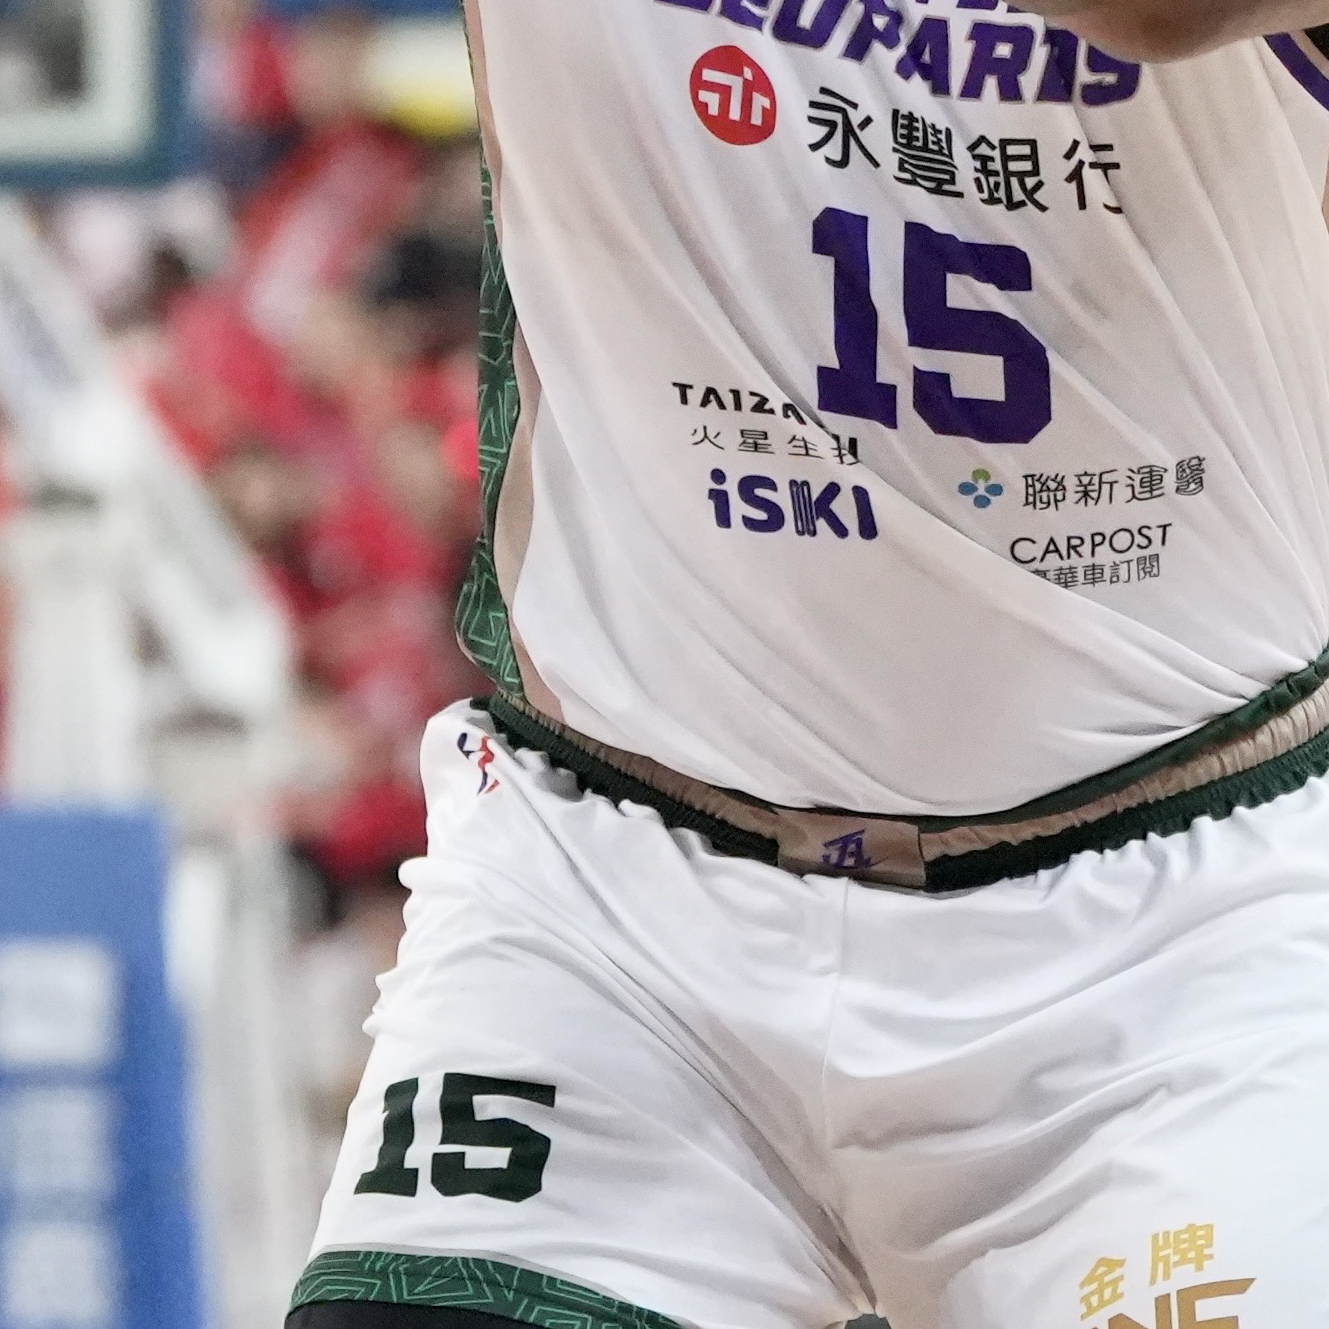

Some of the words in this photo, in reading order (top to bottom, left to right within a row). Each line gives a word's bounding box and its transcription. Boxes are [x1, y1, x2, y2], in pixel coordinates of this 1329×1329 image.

[807, 86, 1124, 214] 永豐銀行
[812, 206, 1052, 444] 15
[1010, 522, 1173, 565] CARPOST
[354, 1072, 557, 1204] 15
[1078, 1223, 1215, 1321] 金牌
